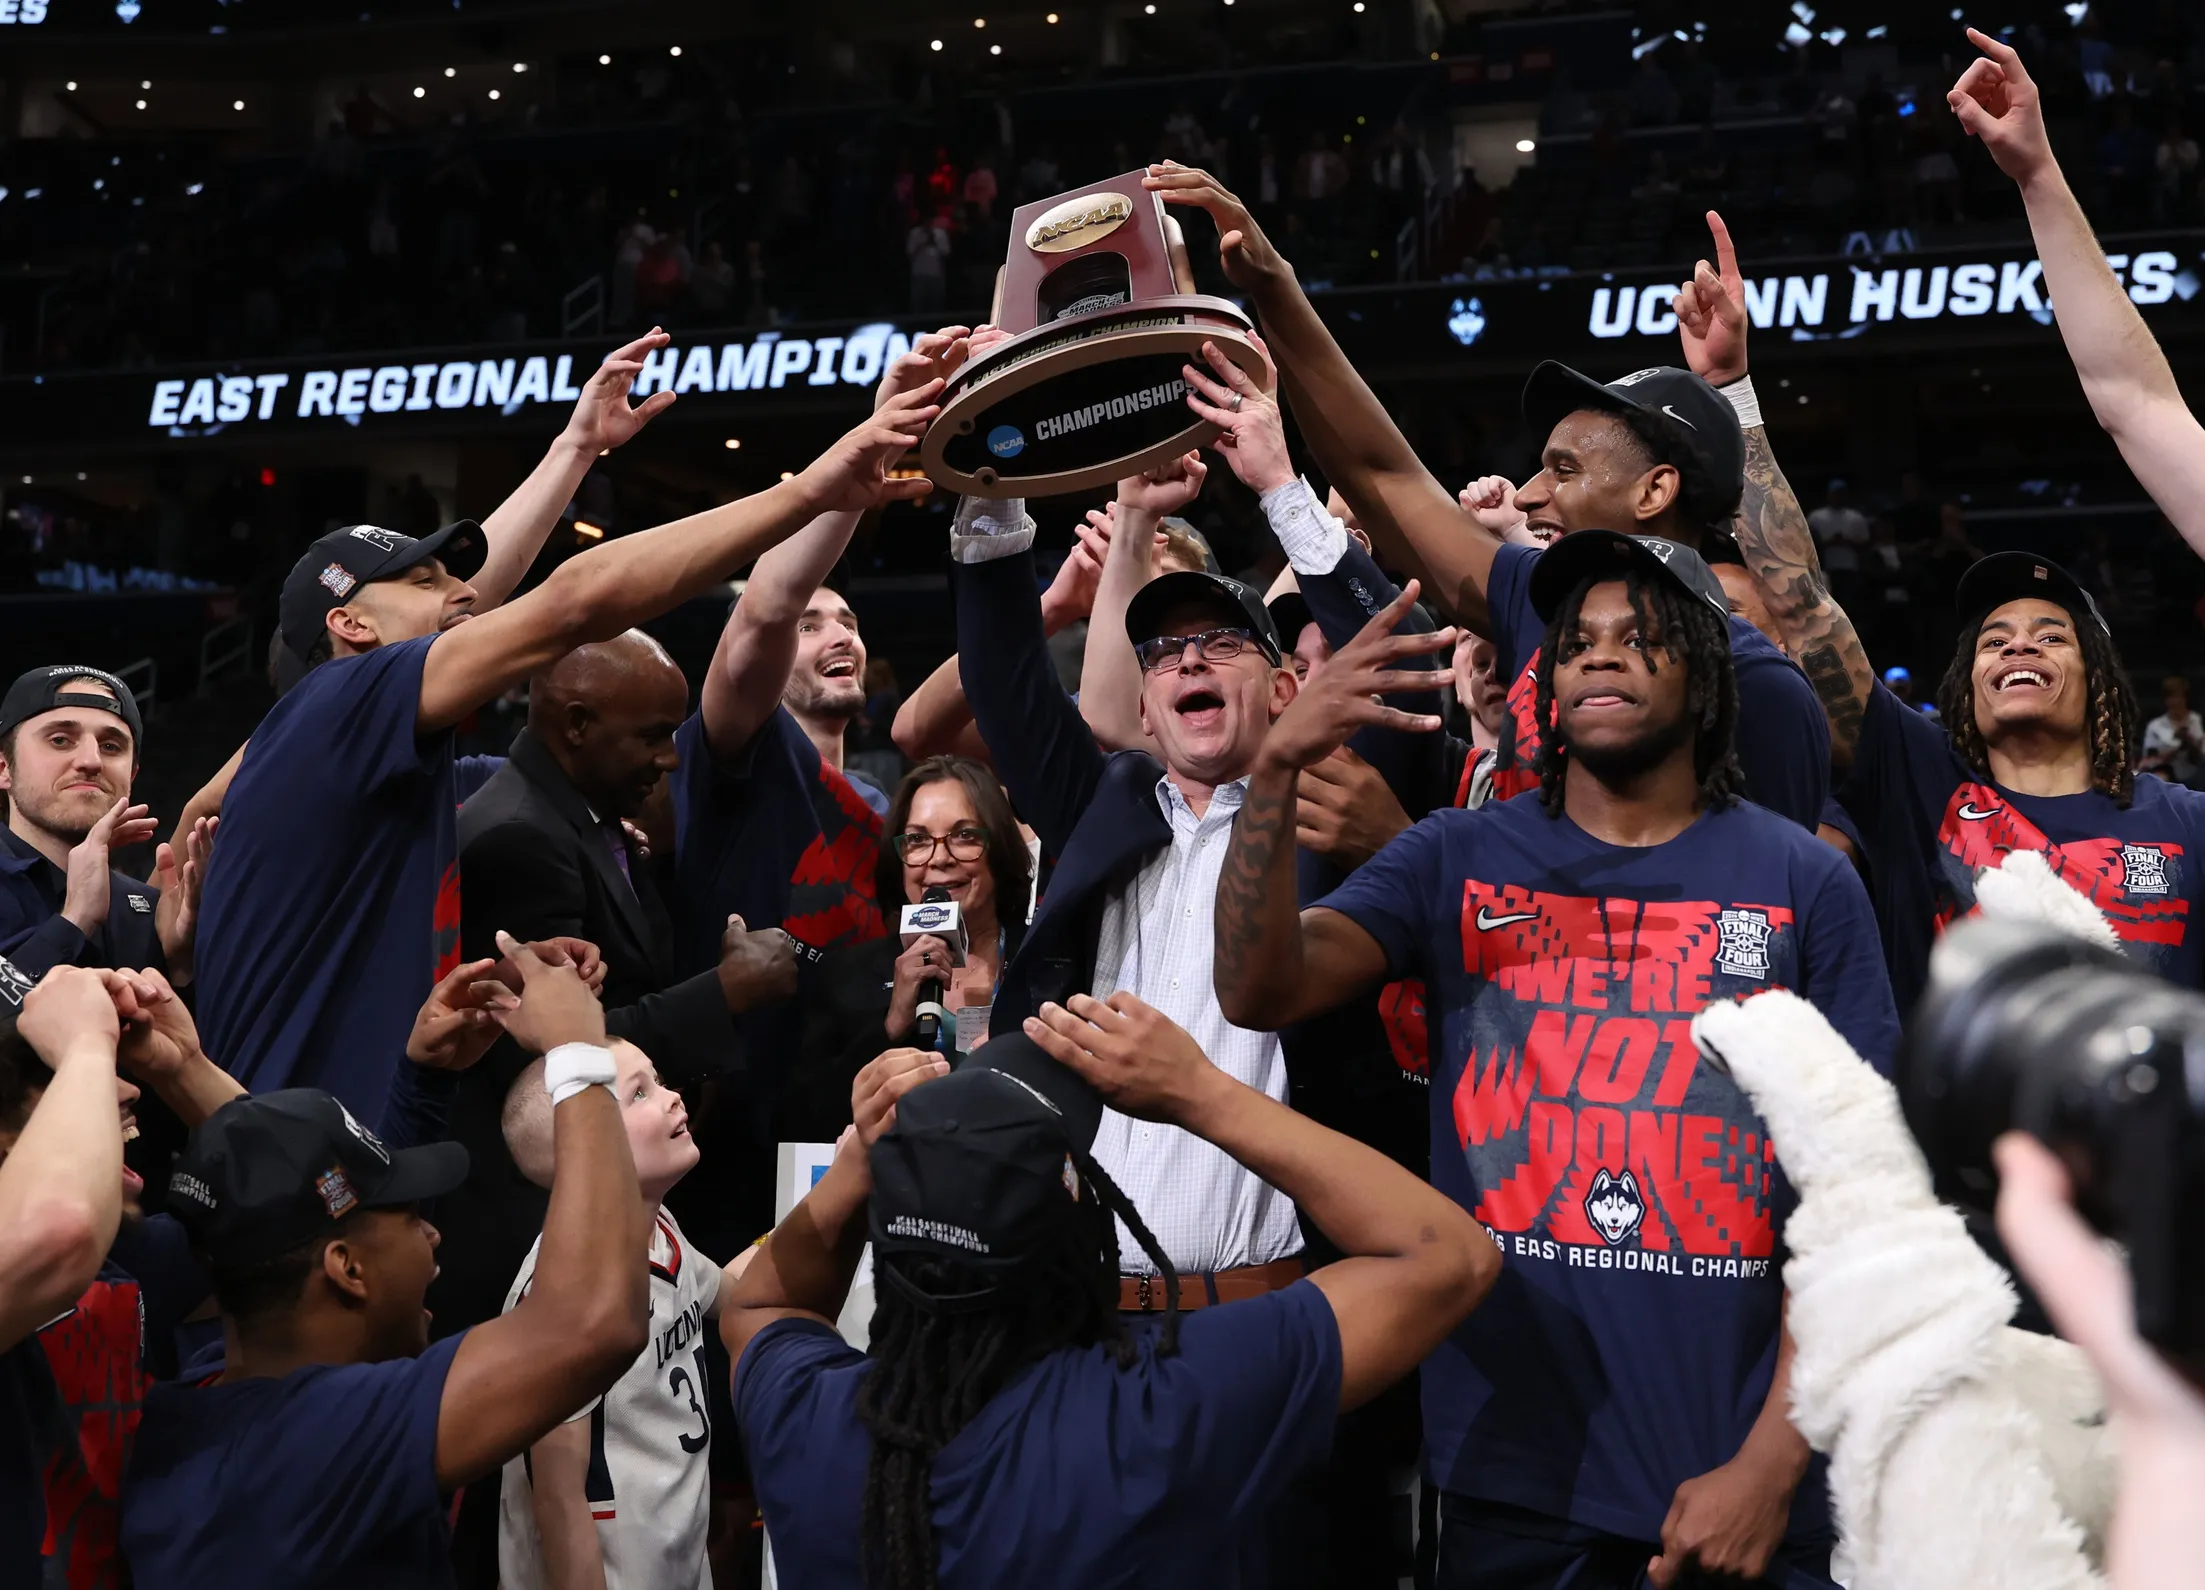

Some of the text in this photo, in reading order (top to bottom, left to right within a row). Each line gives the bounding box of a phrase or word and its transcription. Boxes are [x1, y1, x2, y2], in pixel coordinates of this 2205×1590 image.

[1033, 202, 1126, 248] NCAA
[1589, 251, 2177, 338] UCNN HUSKS
[1070, 298, 1106, 314] MARCH
[148, 373, 289, 427] EAST
[297, 354, 581, 418] REGIONAL
[993, 436, 1025, 453] NCAA
[323, 567, 342, 585] FINAL
[334, 576, 352, 595] FOUR
[2127, 854, 2160, 865] FINAL
[2131, 875, 2163, 885] FOUR
[1723, 921, 1763, 939] FINAL
[1724, 948, 1763, 967] FOUR
[1514, 1236, 1562, 1262] EAST
[1569, 1246, 1684, 1276] REGIONAL
